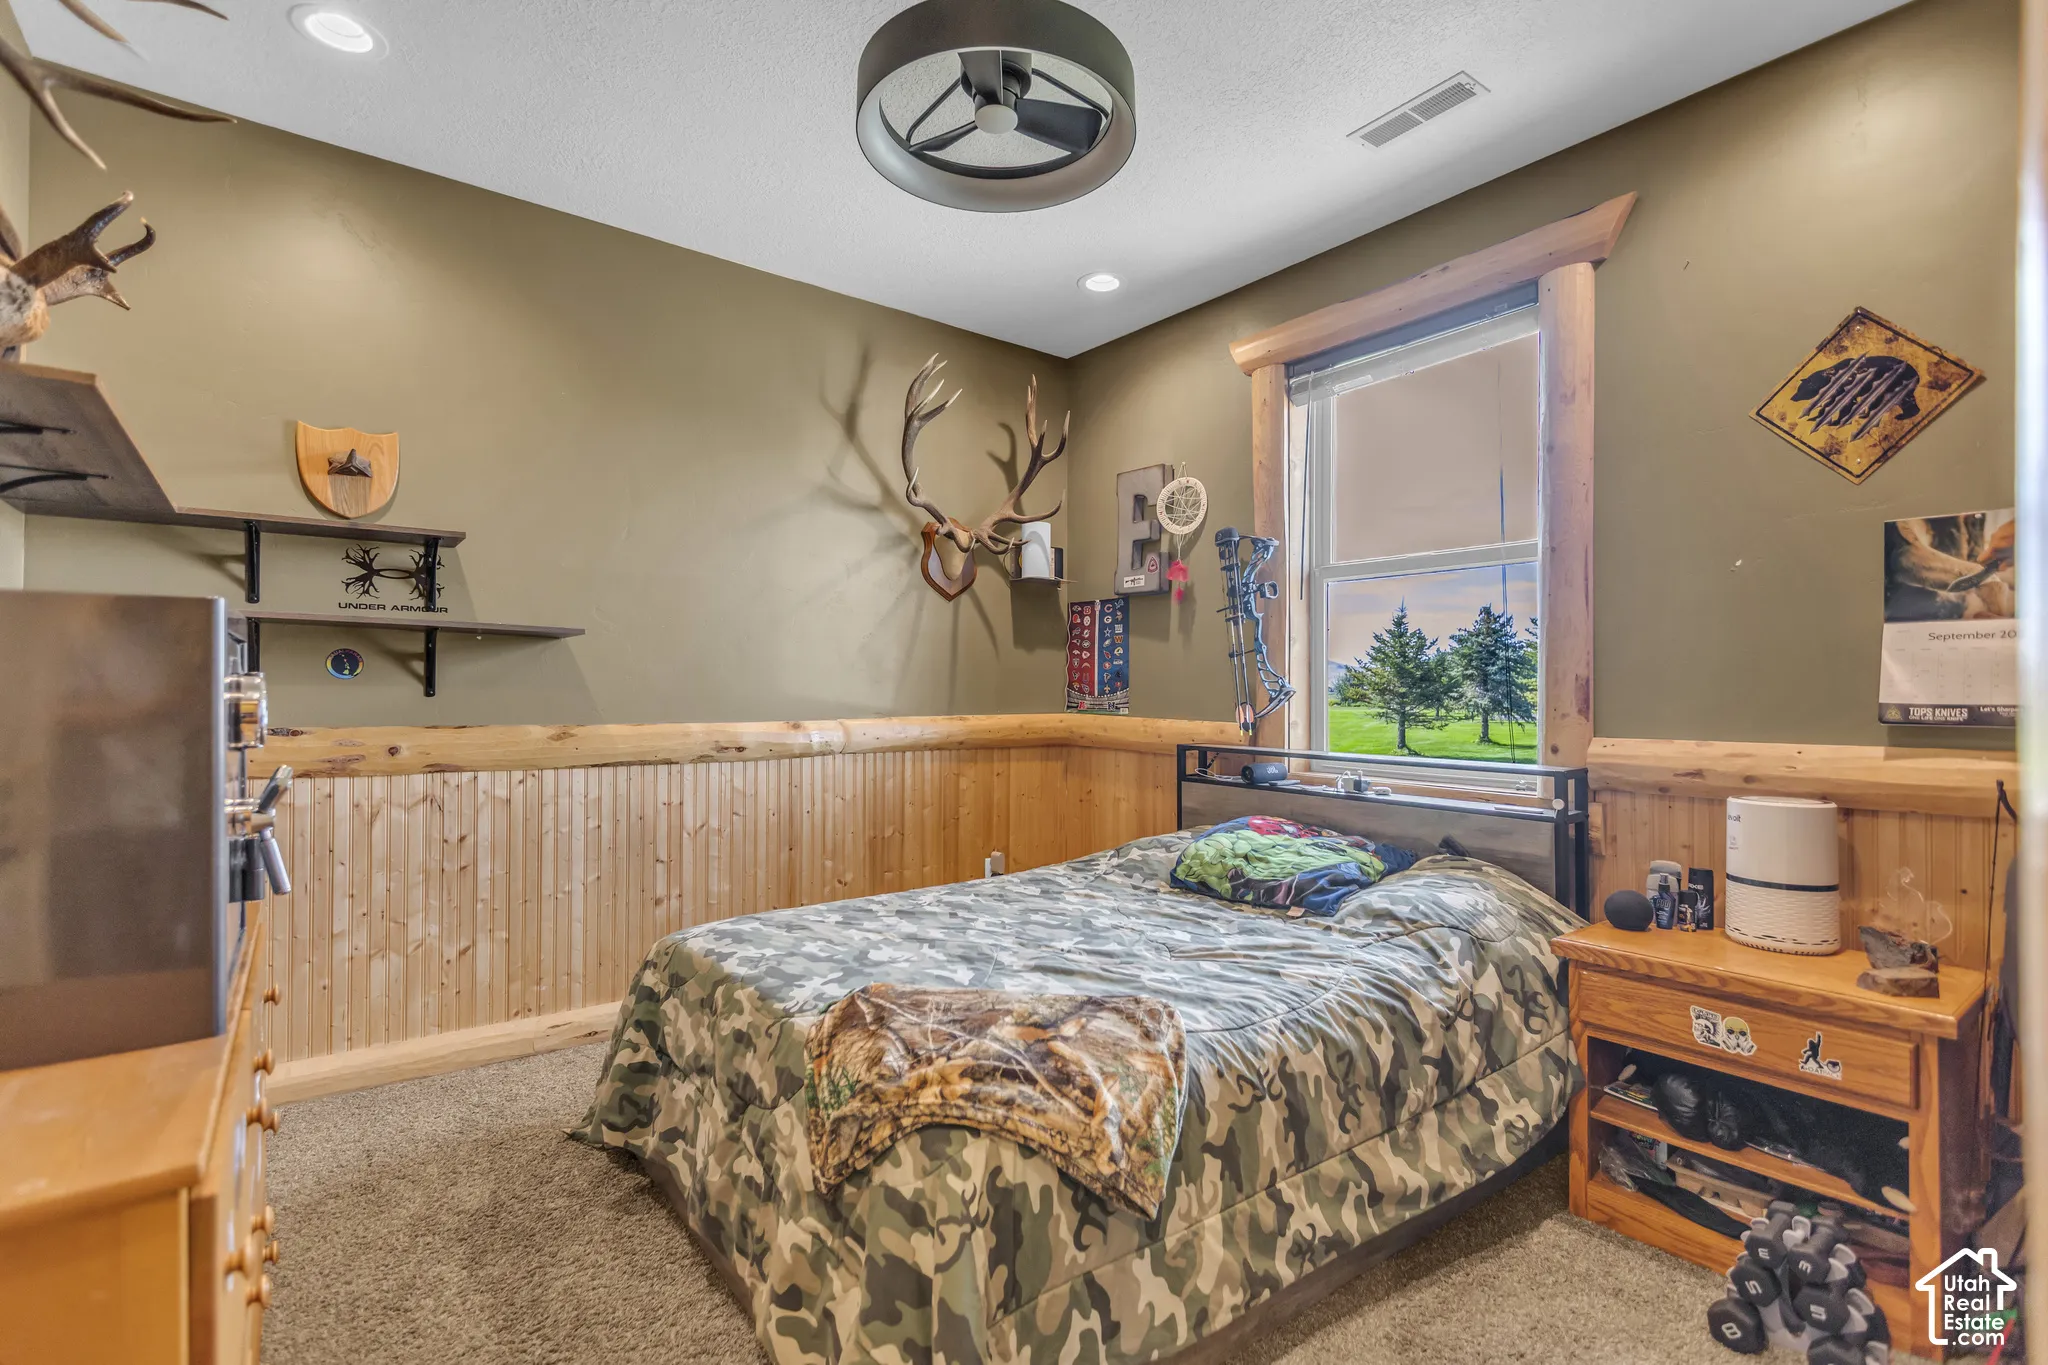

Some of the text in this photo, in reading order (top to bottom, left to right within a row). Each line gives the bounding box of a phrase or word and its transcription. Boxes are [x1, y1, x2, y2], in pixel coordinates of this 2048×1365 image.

[338, 602, 386, 611] UNDER
[1928, 630, 1996, 642] September
[1909, 707, 1968, 717] TOPS KNIVES
